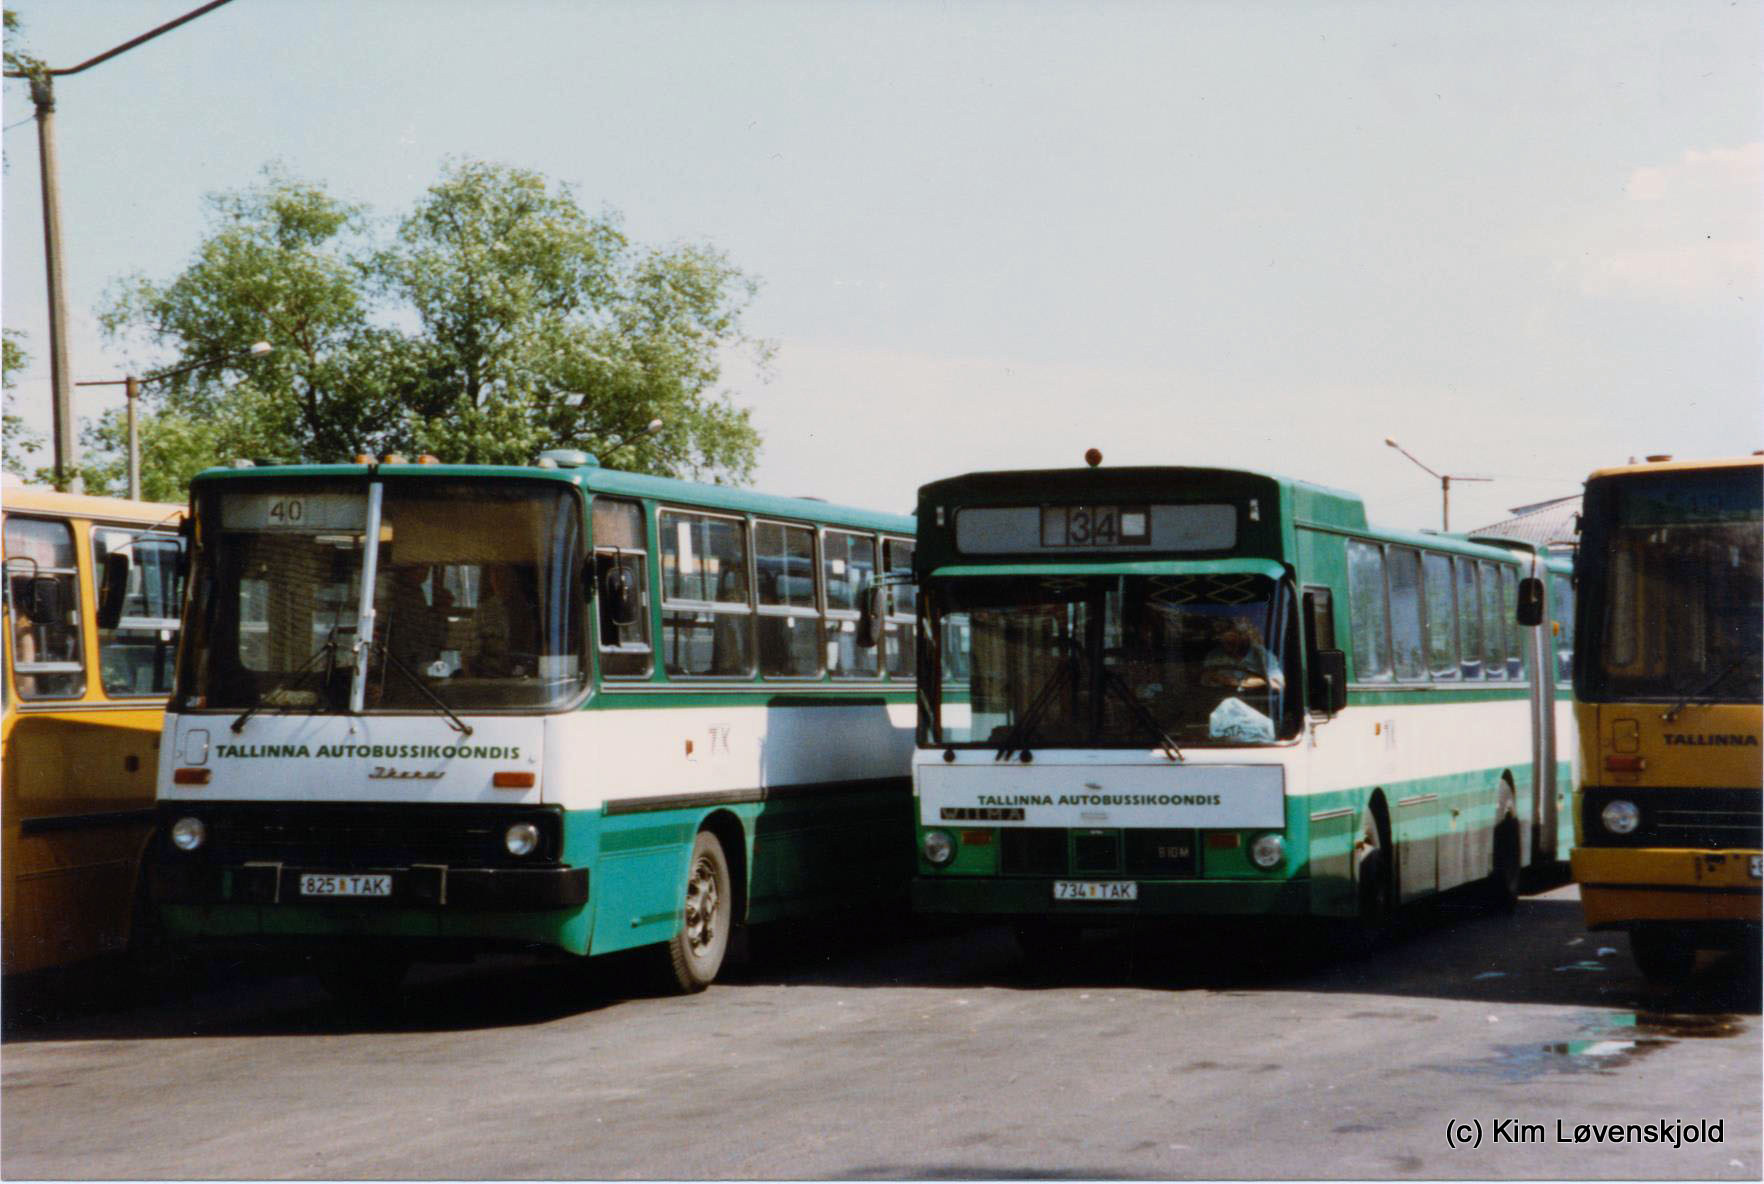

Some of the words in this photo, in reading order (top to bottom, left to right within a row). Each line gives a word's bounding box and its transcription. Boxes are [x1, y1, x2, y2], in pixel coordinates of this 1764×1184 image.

[270, 500, 302, 521] 40
[1070, 511, 1116, 543] 34
[1663, 733, 1758, 747] TALLINNA
[216, 744, 310, 758] TALLINNA
[315, 744, 520, 760] AUTOBUSSIKOONDIS
[977, 794, 1053, 806] TALLINNA
[1058, 794, 1221, 806] AUTOBUSSIKOONDIS
[306, 878, 336, 894] 825
[350, 878, 385, 894] TAK
[1060, 882, 1087, 898] 734
[1099, 882, 1131, 898] TAK
